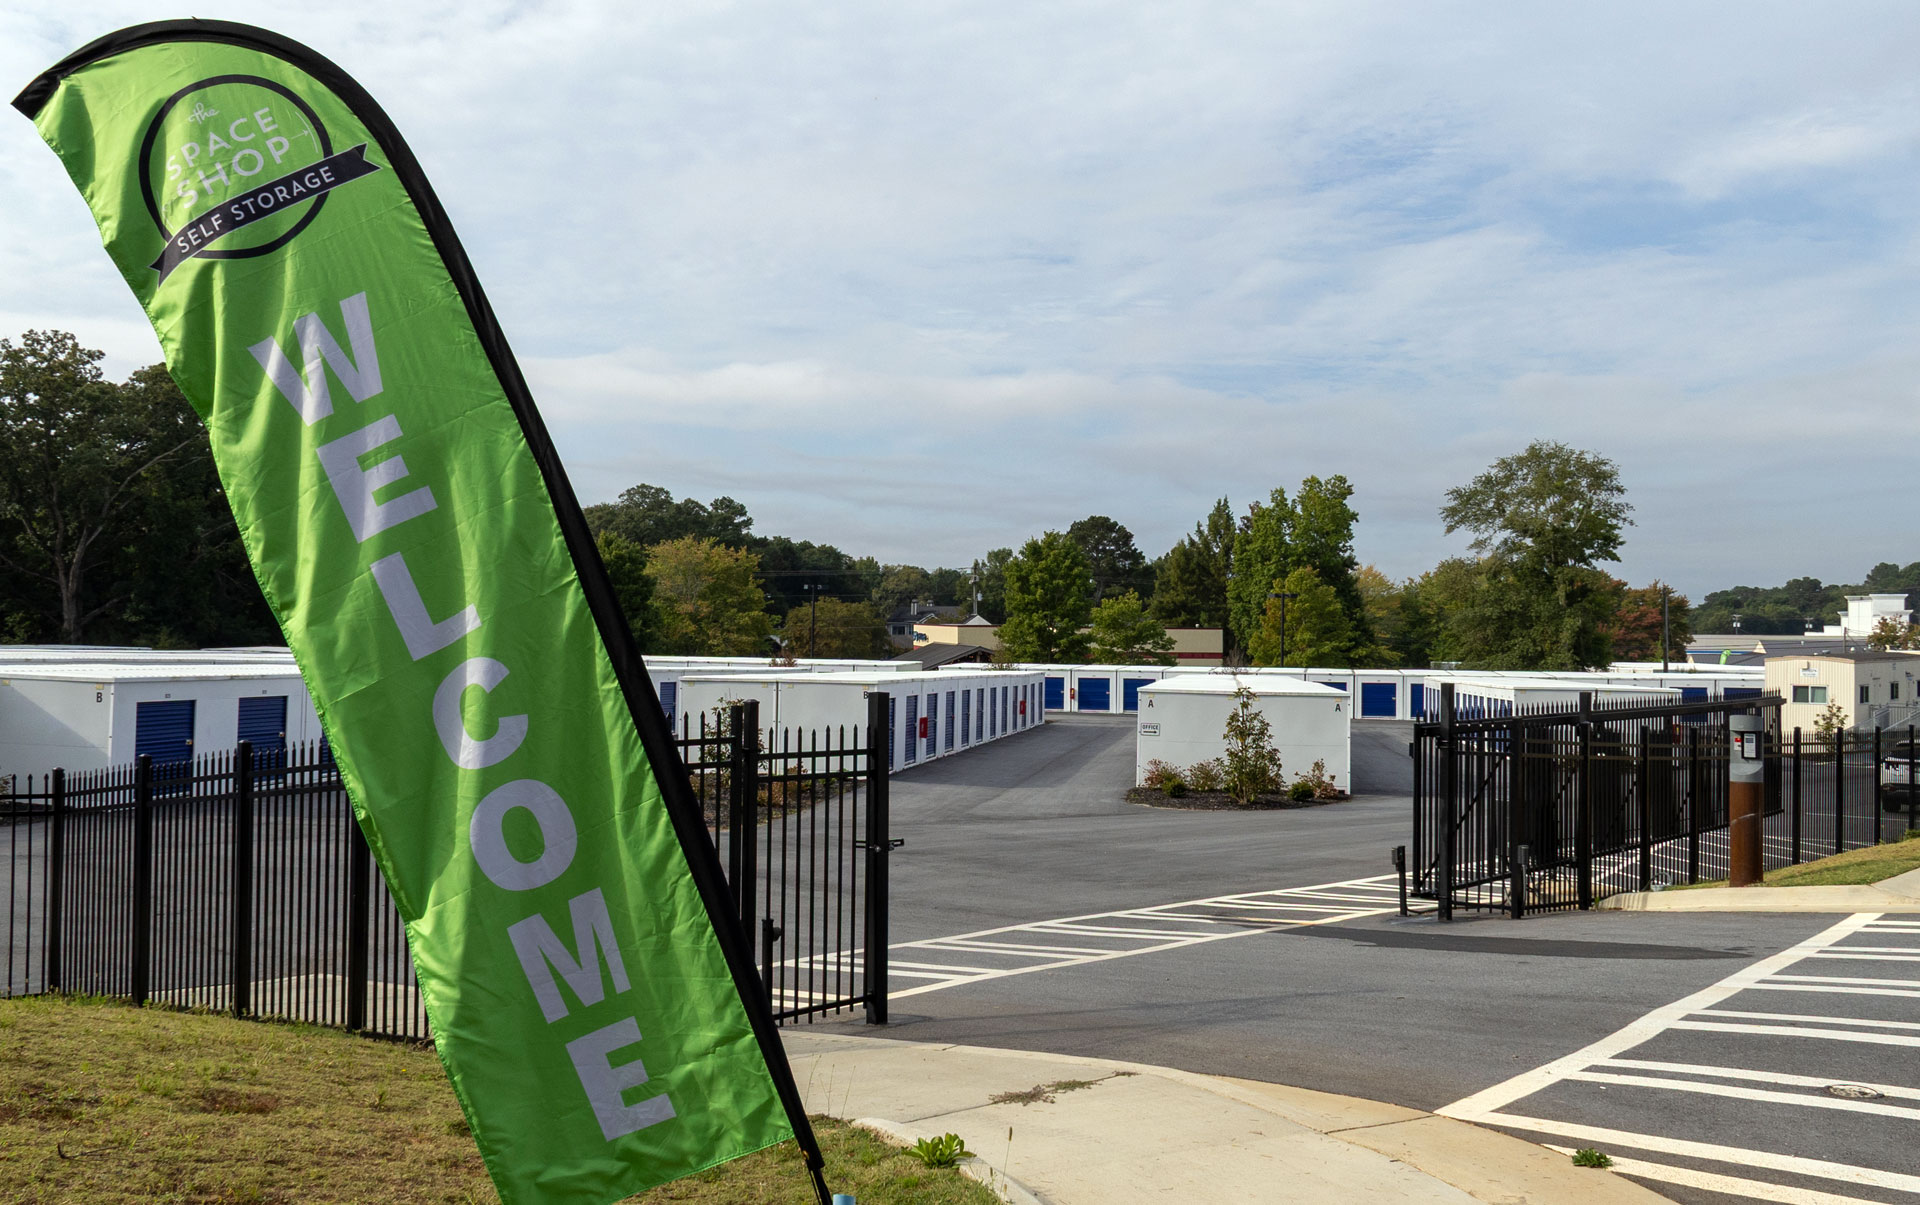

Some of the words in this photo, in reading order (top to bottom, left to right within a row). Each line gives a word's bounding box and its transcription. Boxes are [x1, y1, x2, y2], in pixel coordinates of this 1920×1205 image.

[189, 102, 219, 124] the
[166, 107, 278, 181] SPACE
[176, 136, 290, 209] SHOP
[177, 214, 224, 253] SELF
[231, 166, 335, 221] STORAGE
[96, 692, 103, 702] B
[247, 291, 677, 1142] WELCOME
[1147, 699, 1154, 708] A
[1334, 703, 1341, 712] A
